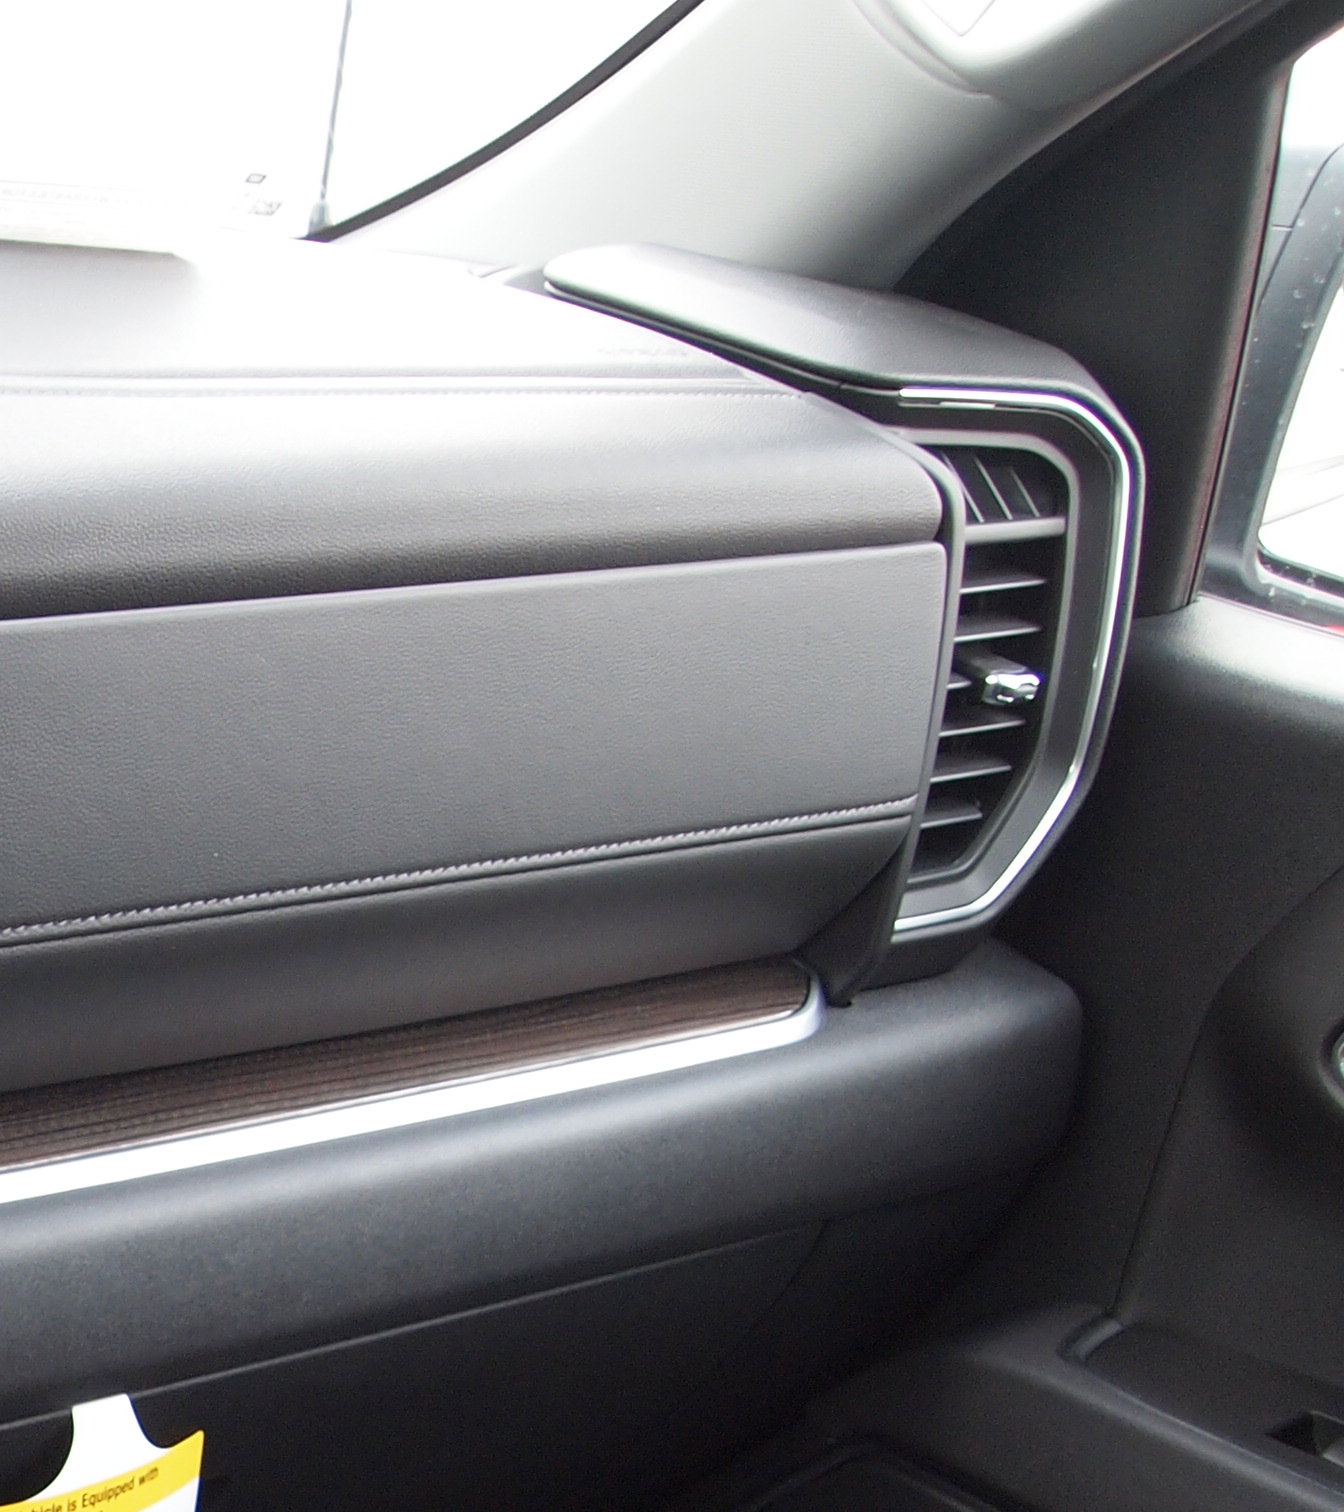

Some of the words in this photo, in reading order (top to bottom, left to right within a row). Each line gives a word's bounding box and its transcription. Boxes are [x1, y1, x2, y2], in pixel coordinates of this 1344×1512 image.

[67, 1499, 77, 1512] is
[81, 1476, 135, 1508] Equipped
[138, 1467, 159, 1486] with
